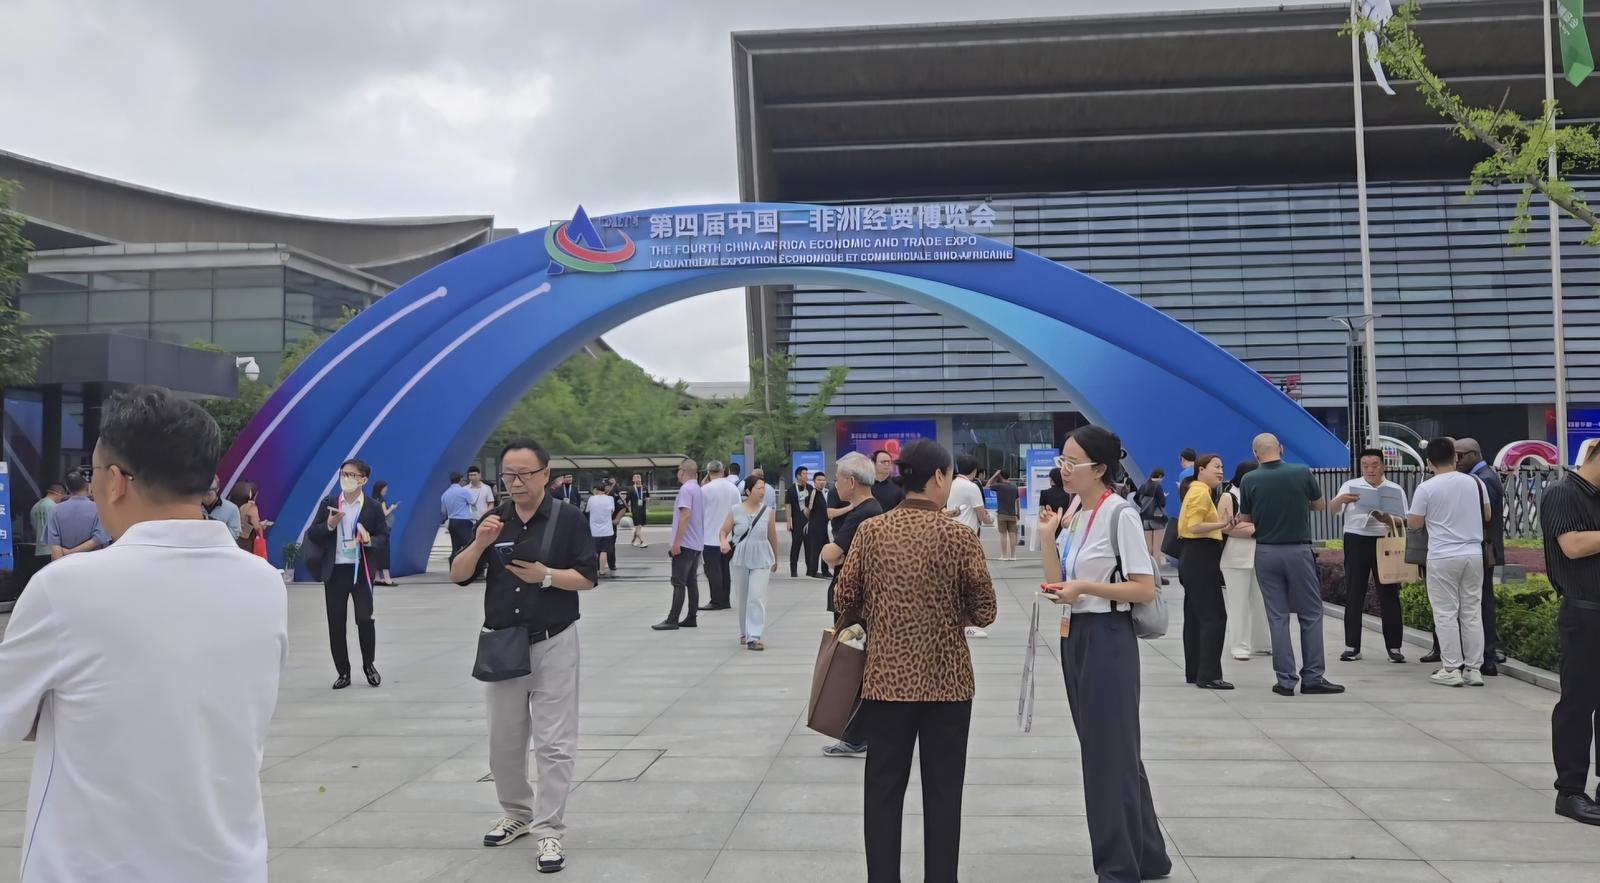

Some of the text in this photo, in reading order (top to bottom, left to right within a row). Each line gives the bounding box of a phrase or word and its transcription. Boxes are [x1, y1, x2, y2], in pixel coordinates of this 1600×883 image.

[649, 245, 672, 255] THE
[675, 243, 721, 254] FOURTH
[809, 238, 871, 249] ECONOMIC
[874, 237, 899, 248] AND
[902, 236, 942, 247] TRADE
[945, 236, 977, 246] EXPO
[845, 253, 859, 262] ET
